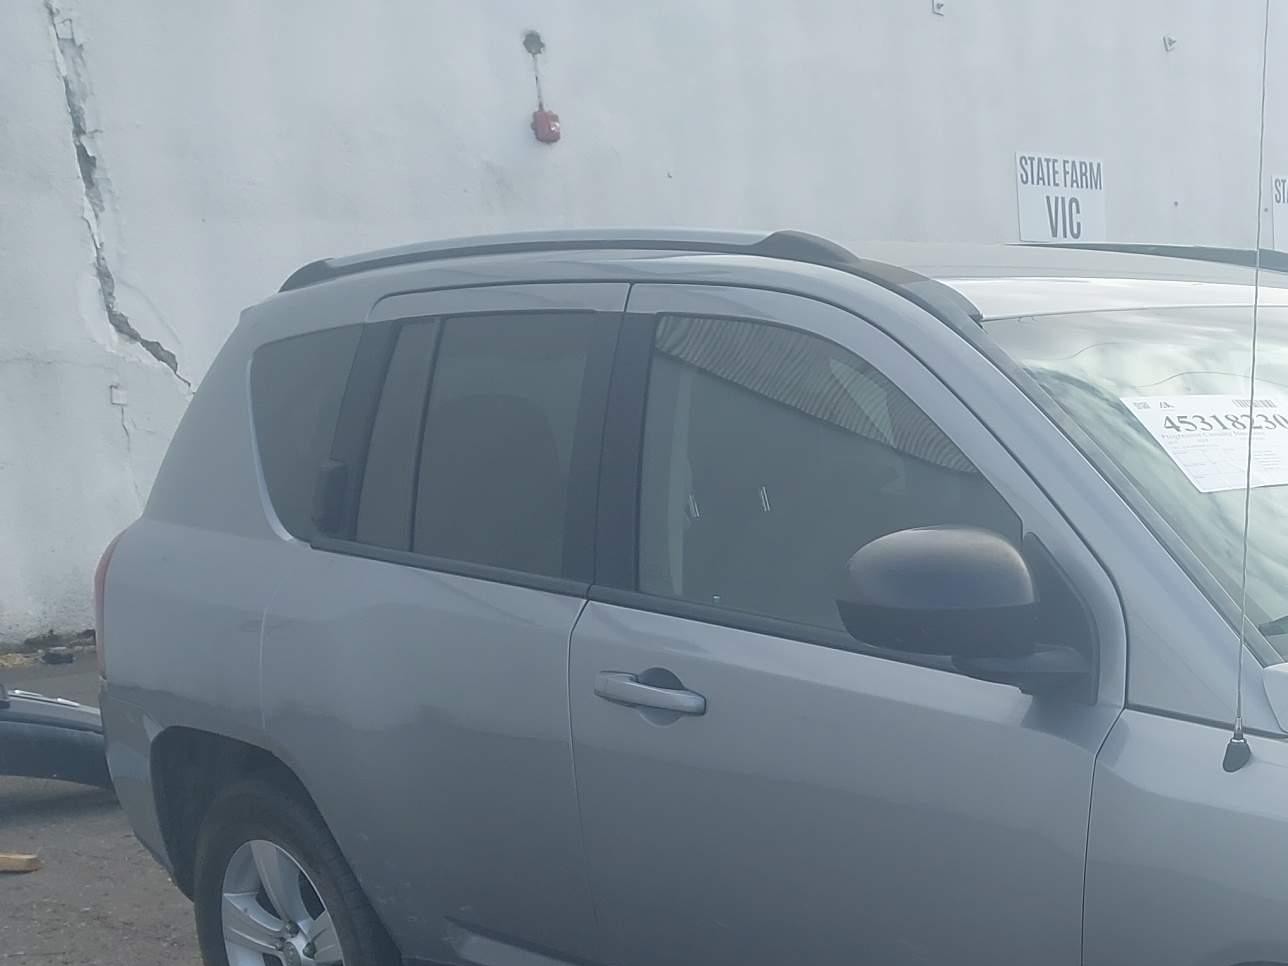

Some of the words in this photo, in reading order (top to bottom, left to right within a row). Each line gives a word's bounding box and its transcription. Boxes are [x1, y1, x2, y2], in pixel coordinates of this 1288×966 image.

[1019, 155, 1060, 187] STATE
[1063, 159, 1103, 190] FARM
[1046, 195, 1082, 239] VIC
